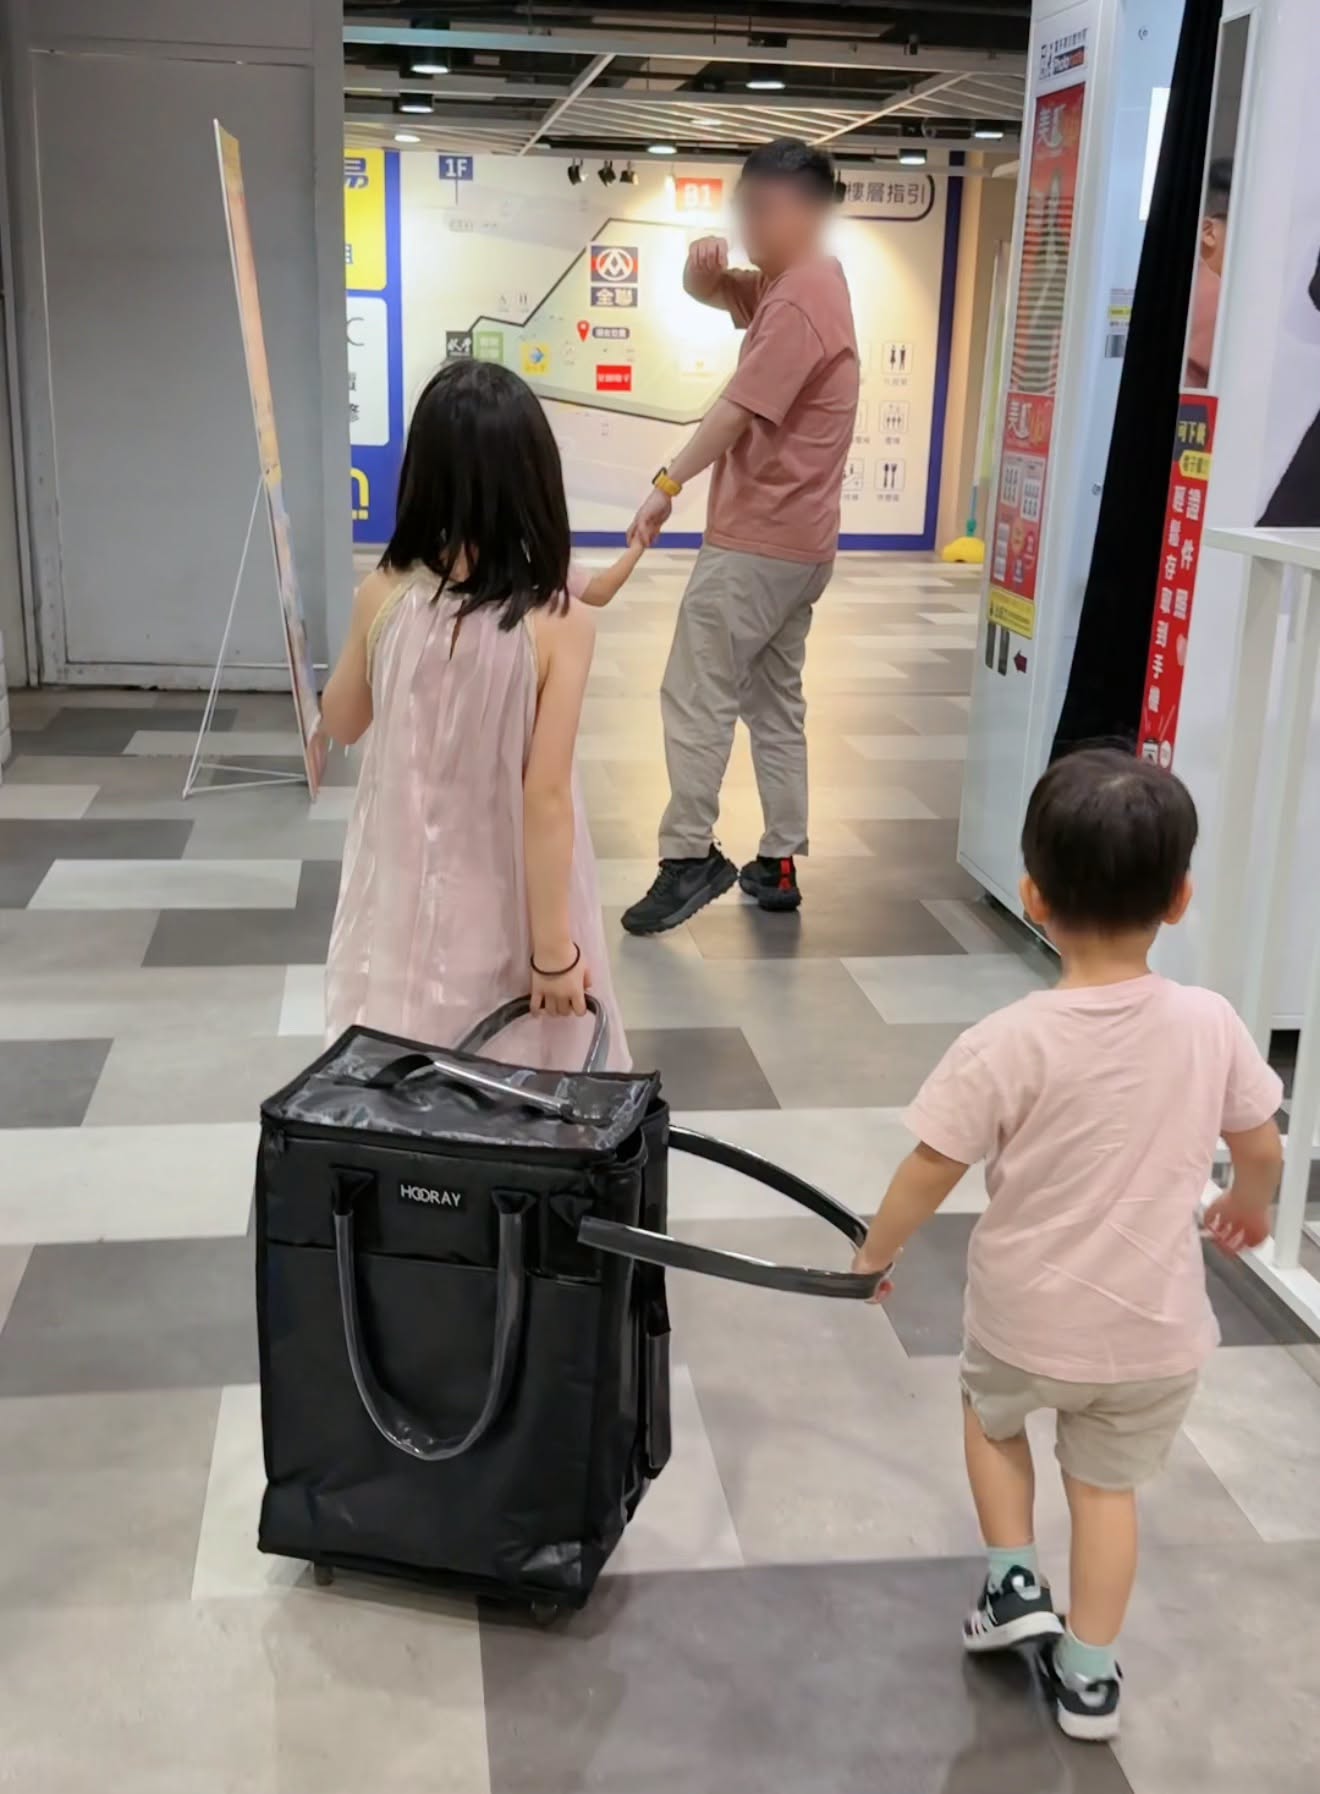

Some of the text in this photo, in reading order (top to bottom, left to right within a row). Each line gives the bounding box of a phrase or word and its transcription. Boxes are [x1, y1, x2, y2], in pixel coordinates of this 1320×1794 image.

[445, 158, 468, 178] 1F
[846, 182, 926, 205] 樓層指引
[596, 288, 633, 306] 全聯
[400, 1184, 461, 1207] HOORAY
